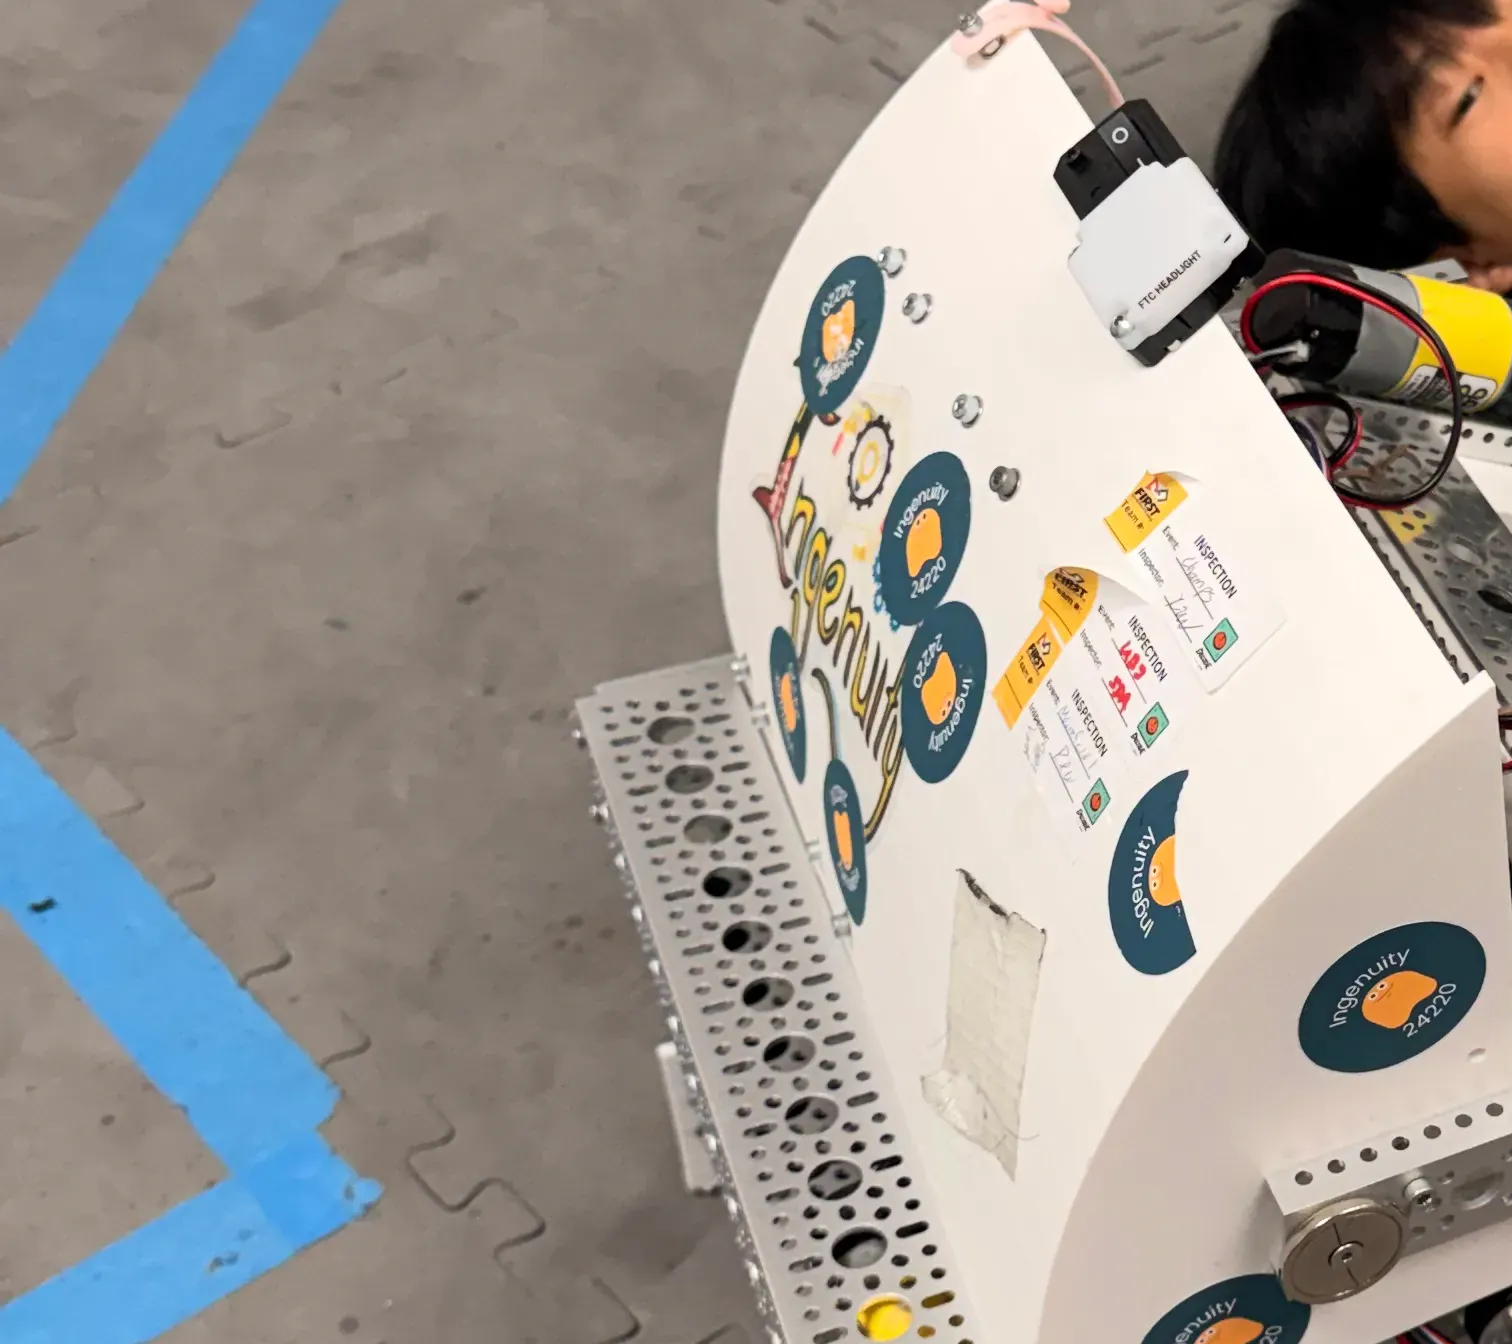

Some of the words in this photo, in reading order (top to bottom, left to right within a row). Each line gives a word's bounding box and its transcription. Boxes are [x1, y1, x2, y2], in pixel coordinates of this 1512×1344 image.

[1138, 292, 1157, 309] FTC
[1154, 250, 1201, 295] HEADLIGHT
[894, 481, 950, 539] Ingenuity
[1135, 487, 1161, 516] FIRST
[909, 555, 947, 599] 24220
[1193, 534, 1238, 599] INSPECTION
[912, 632, 944, 689] 24220
[1128, 615, 1168, 683] INSPECTION
[927, 678, 973, 753] Ingenuity
[1071, 689, 1108, 757] INSPECTION
[1131, 826, 1156, 939] Ingenuity
[1328, 948, 1411, 1029] Ingenuity
[1402, 982, 1457, 1038] 24220
